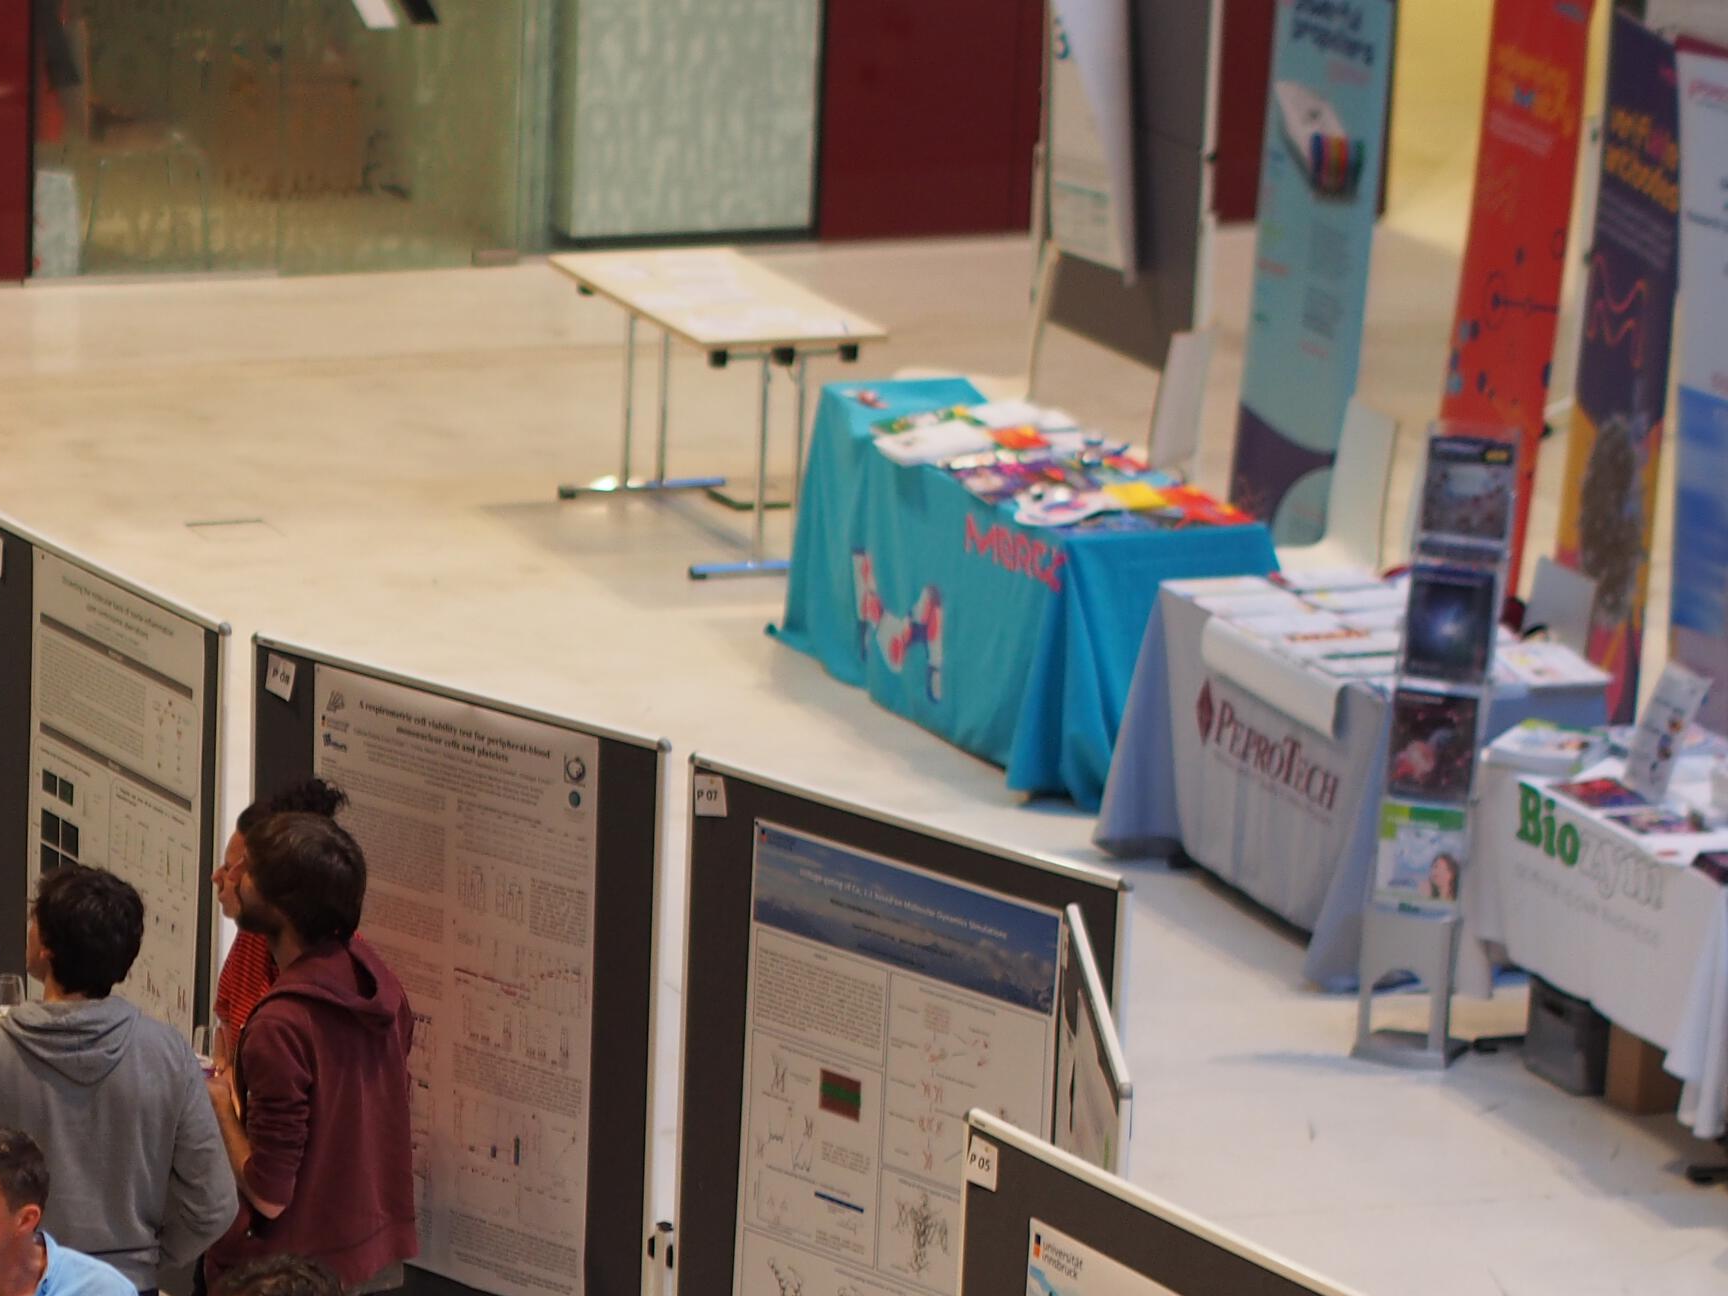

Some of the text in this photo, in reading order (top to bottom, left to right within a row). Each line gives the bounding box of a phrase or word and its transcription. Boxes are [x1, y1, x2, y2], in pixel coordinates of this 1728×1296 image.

[697, 788, 719, 802] P 07
[970, 1152, 990, 1172] P 05
